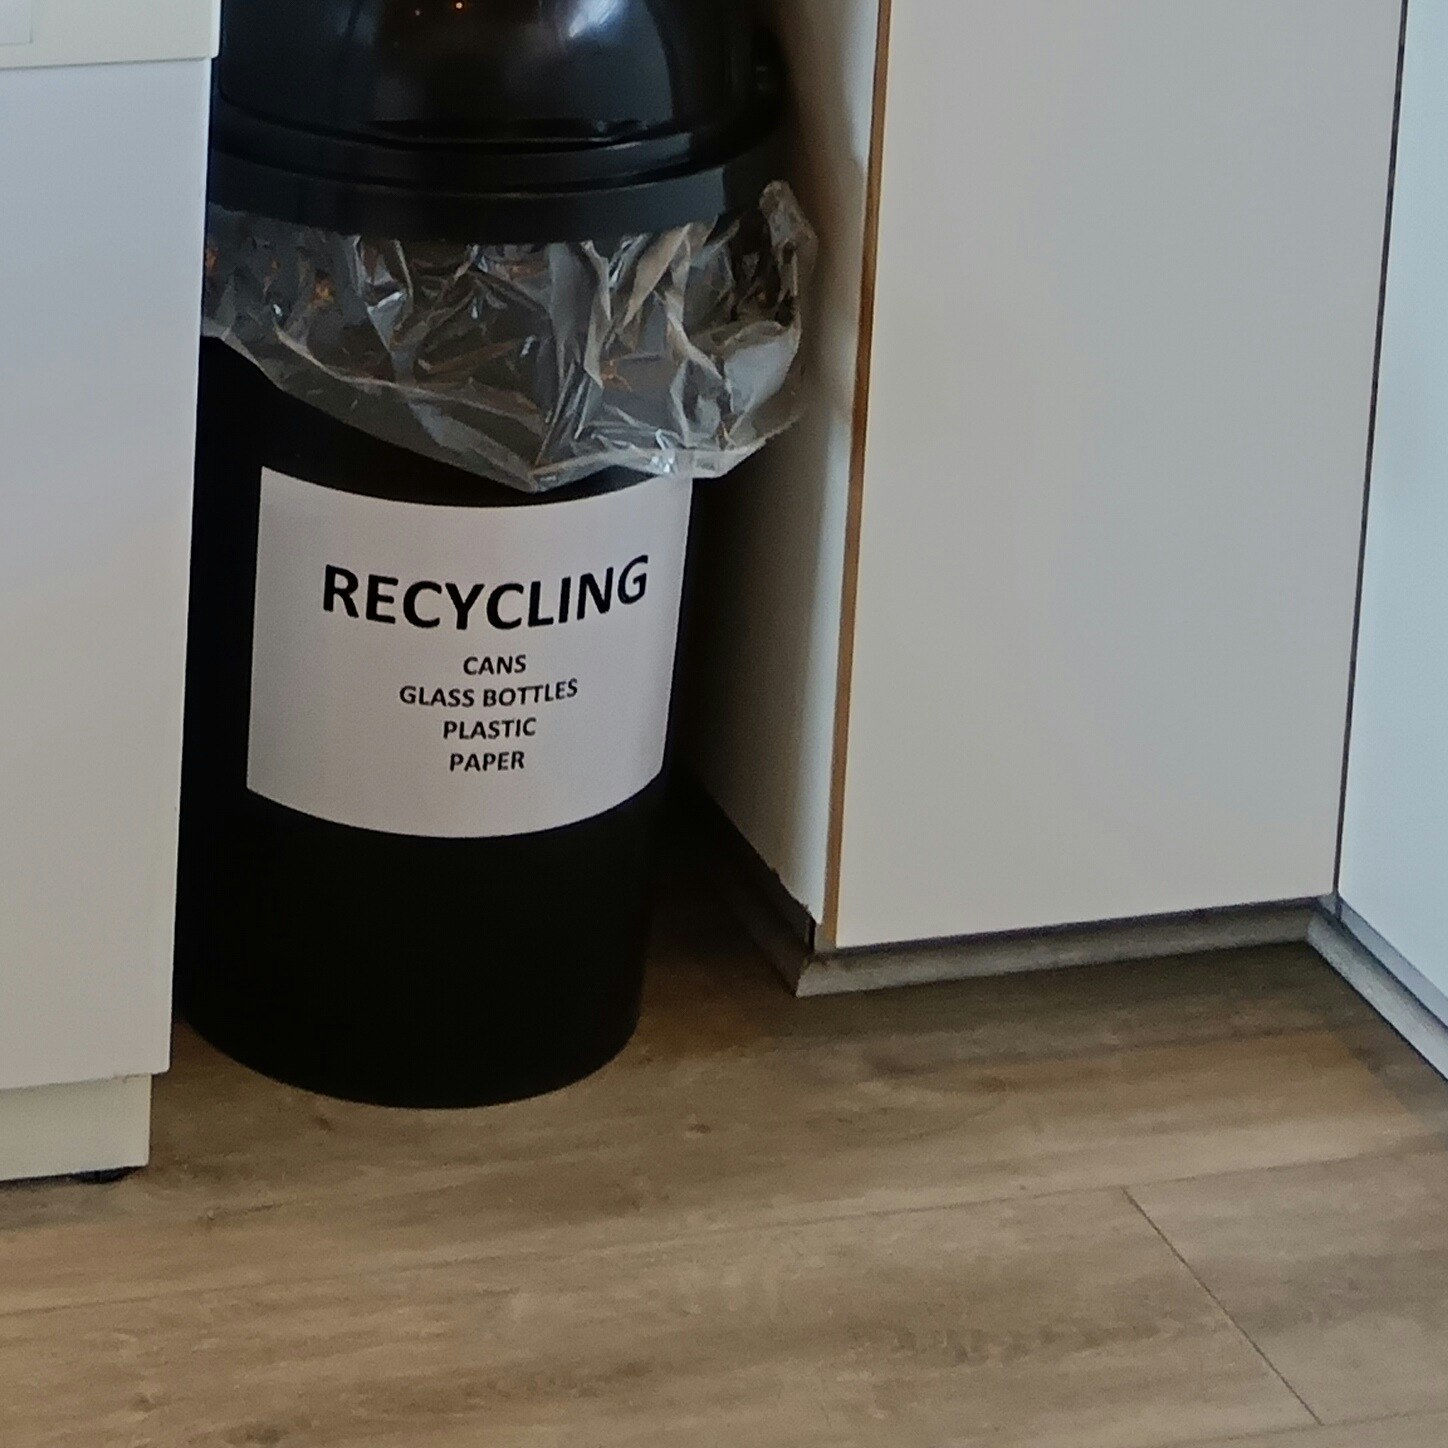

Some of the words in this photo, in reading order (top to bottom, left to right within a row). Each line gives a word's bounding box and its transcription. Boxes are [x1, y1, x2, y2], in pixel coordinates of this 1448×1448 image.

[322, 554, 650, 631] RECYCLING
[462, 654, 528, 677] CANS
[399, 685, 476, 708] GLASS
[482, 678, 579, 708] BOTTLES
[442, 717, 538, 741] PLASTIC
[448, 751, 526, 773] PAPER
